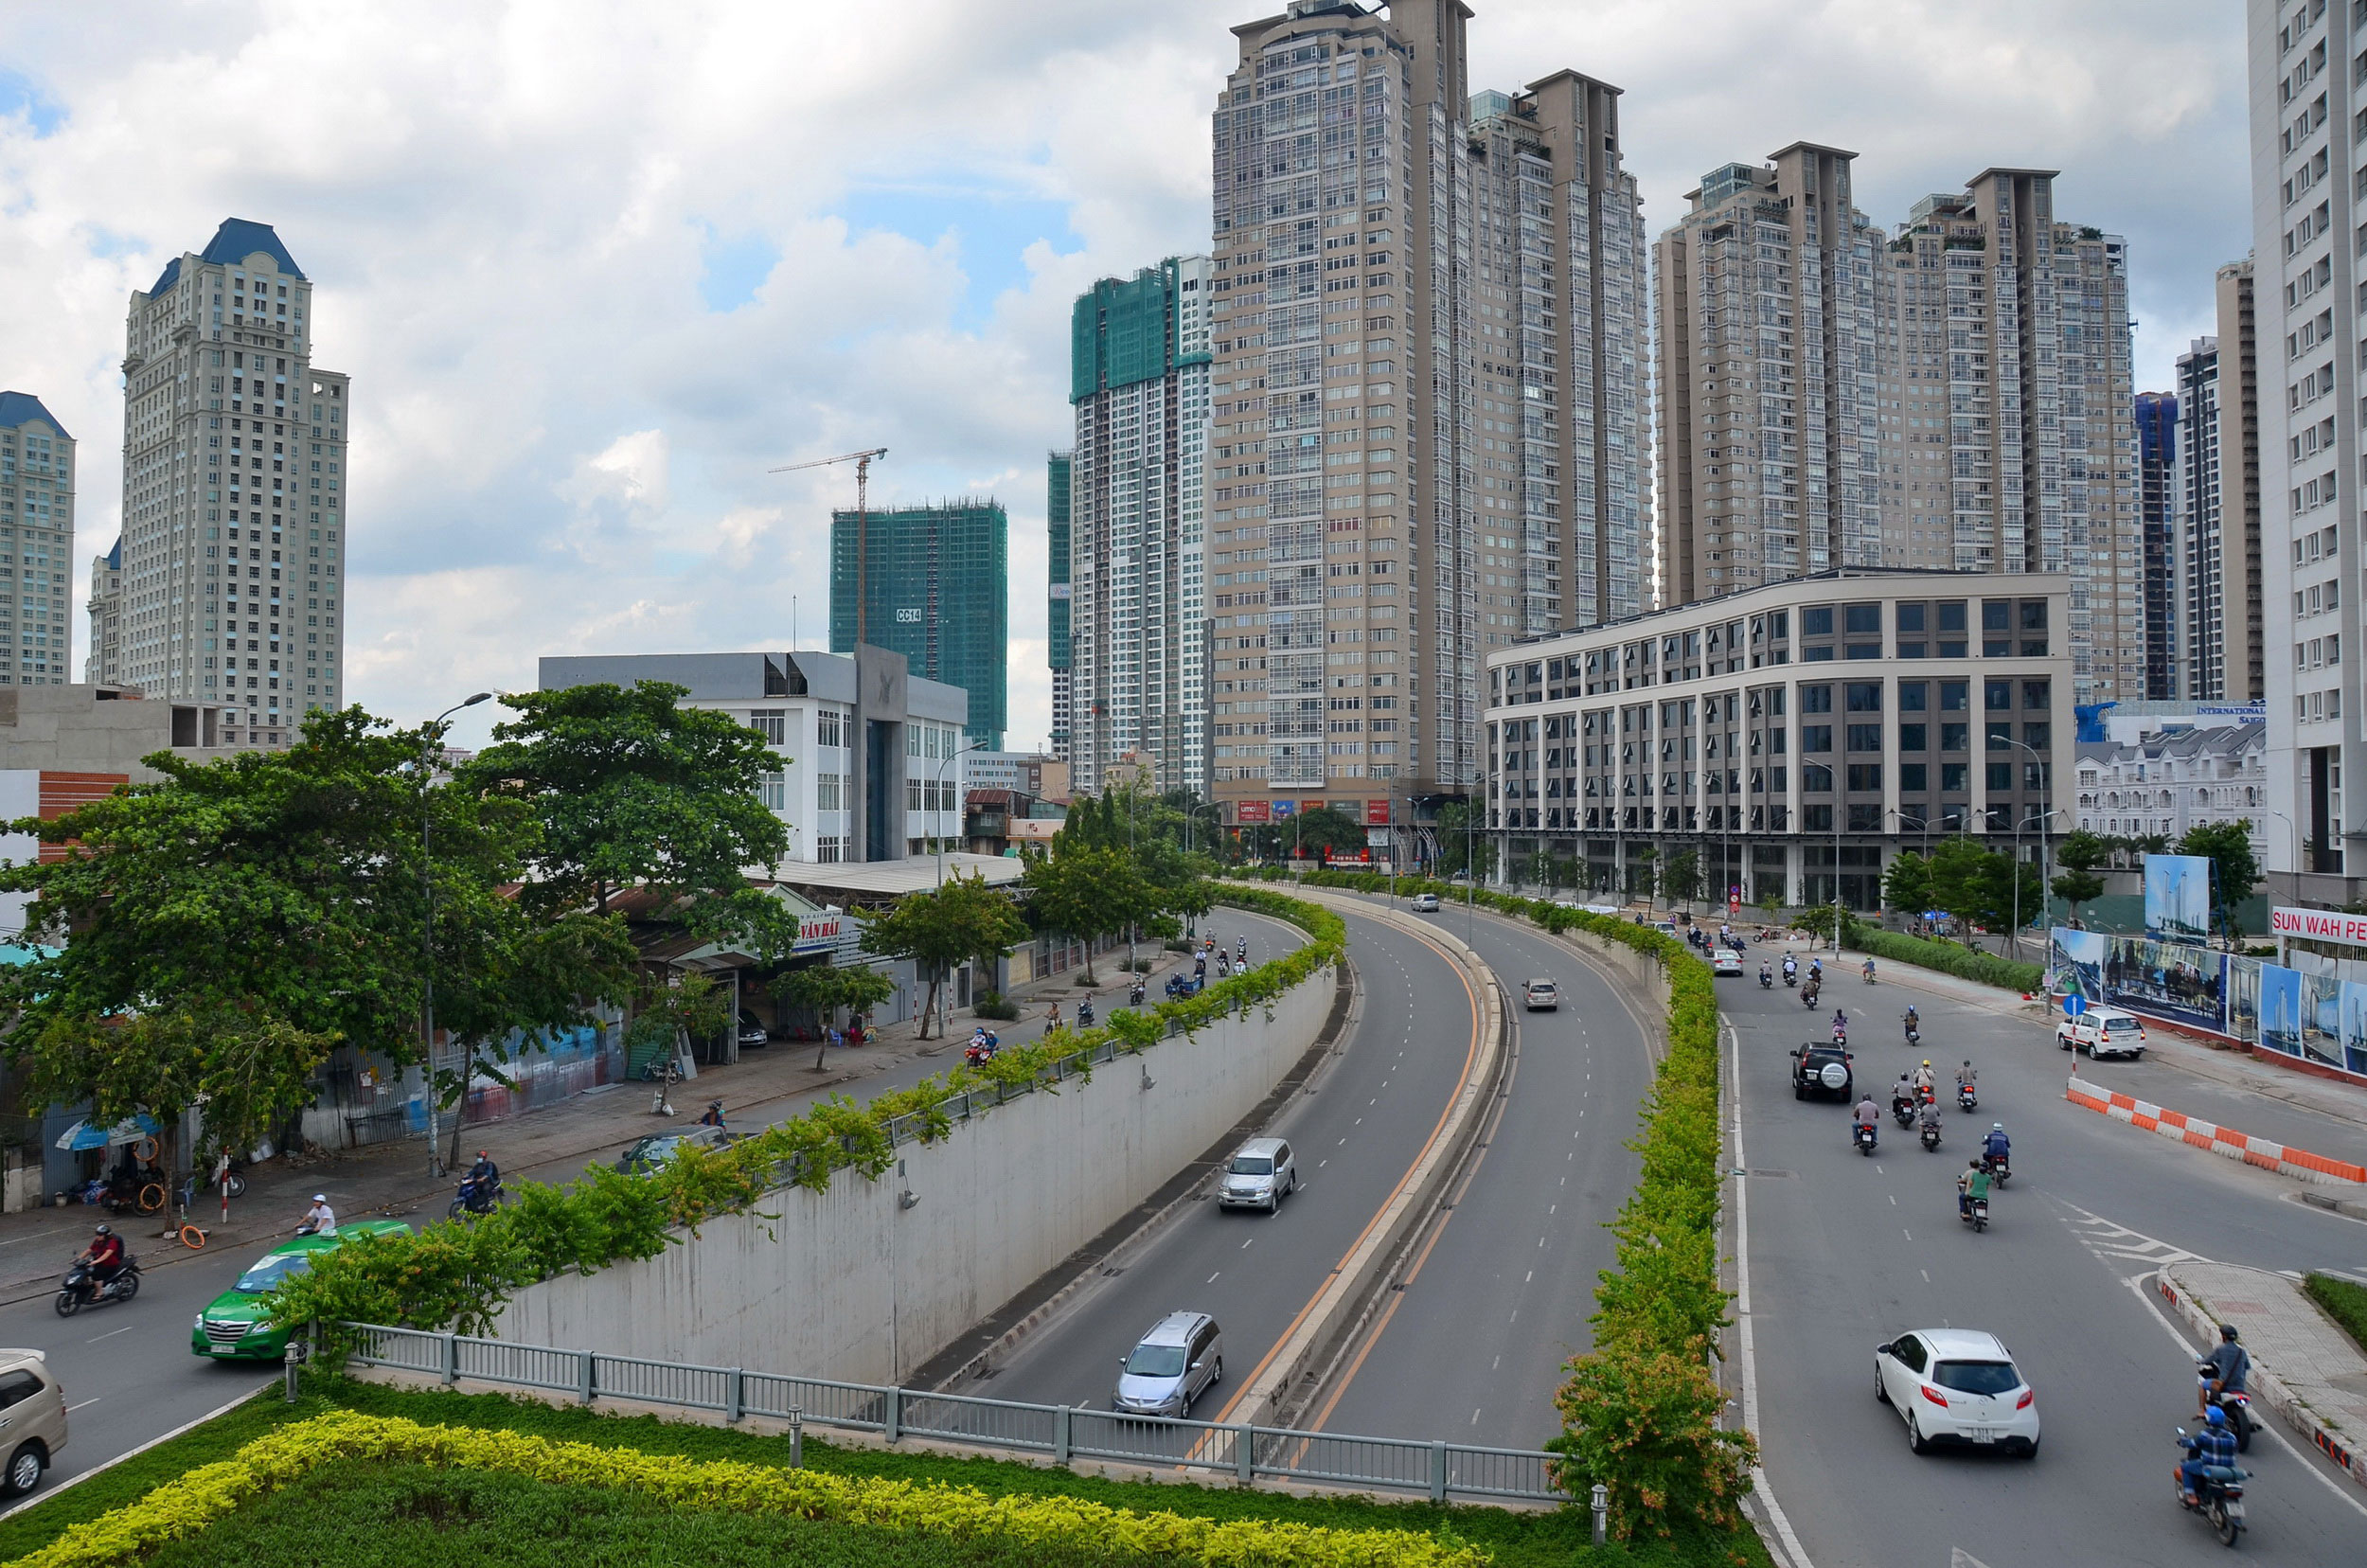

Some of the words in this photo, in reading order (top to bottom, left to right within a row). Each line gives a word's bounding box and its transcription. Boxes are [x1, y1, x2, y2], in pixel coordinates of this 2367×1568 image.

[898, 610, 920, 621] CC14
[2197, 706, 2266, 715] INTERNATIONAL
[2272, 912, 2301, 932] SUN
[2305, 916, 2340, 937] WAH
